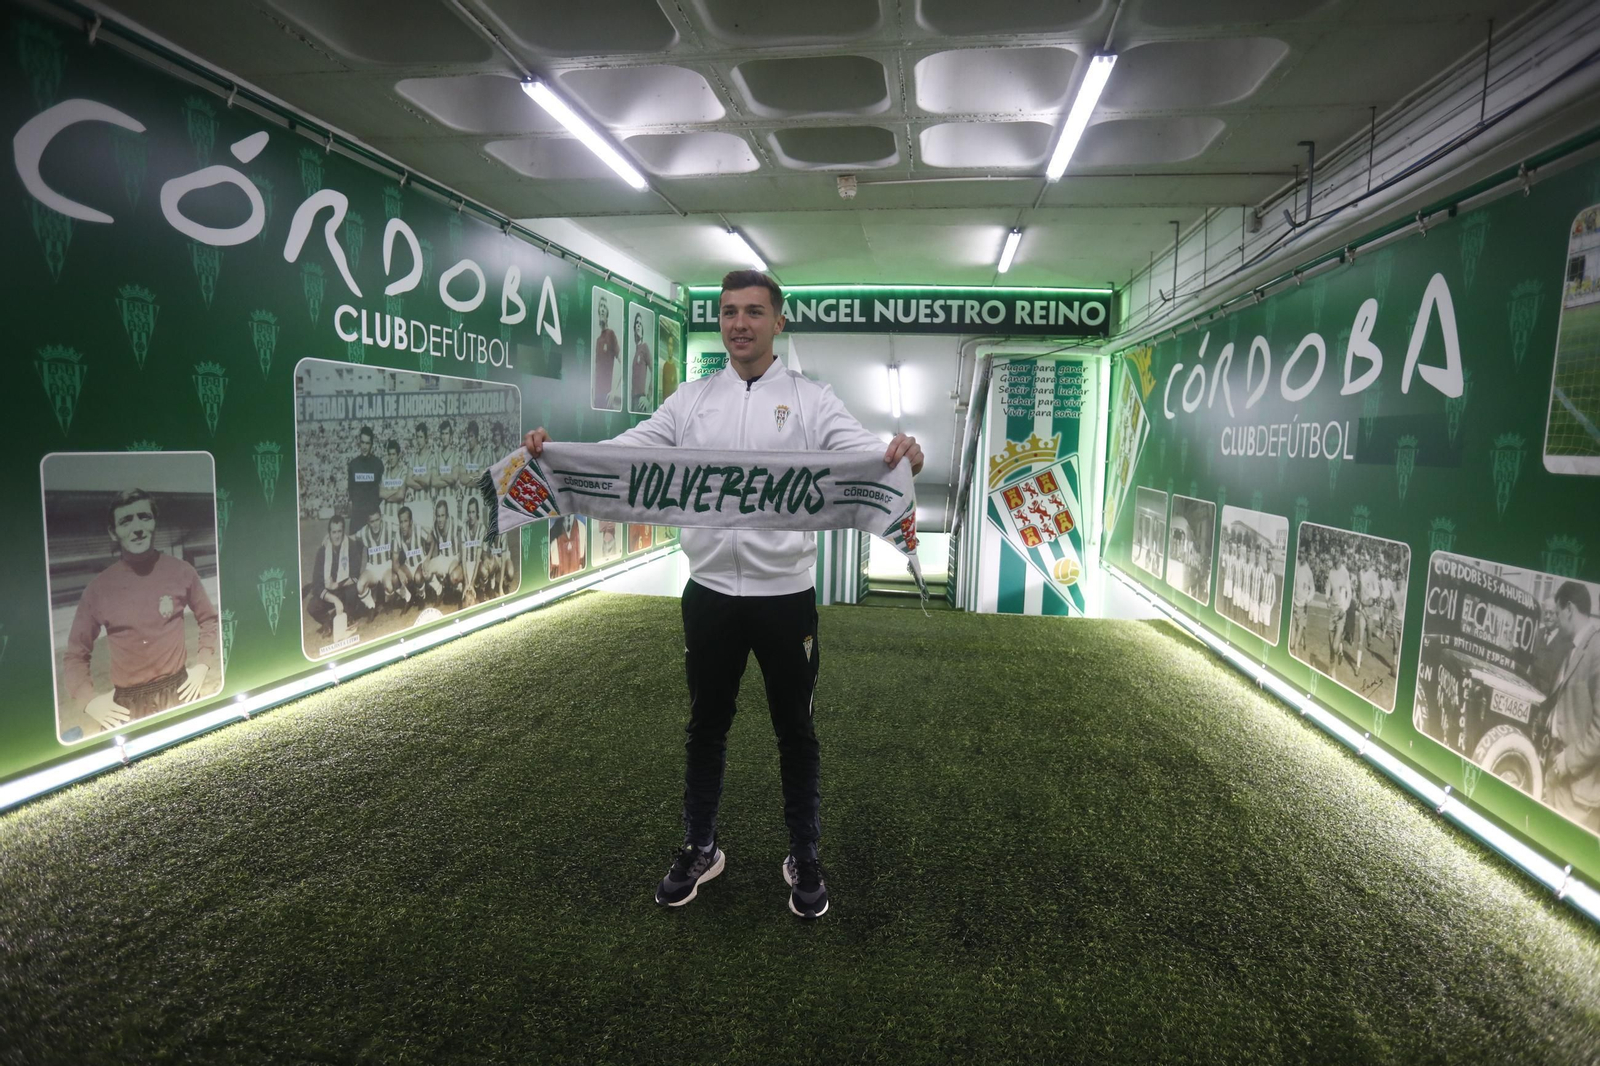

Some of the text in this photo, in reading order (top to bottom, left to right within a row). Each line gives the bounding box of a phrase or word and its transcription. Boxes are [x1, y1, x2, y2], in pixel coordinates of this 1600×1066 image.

[14, 99, 561, 345] CÓRDOBA
[692, 300, 718, 323] EL
[874, 299, 1006, 325] NUESTRO
[1015, 301, 1106, 326] REINO
[1164, 272, 1464, 419] CÓRDOBA
[1001, 363, 1089, 375] Jugar para ganar
[1000, 374, 1089, 385] Ganar para sentir
[998, 386, 1090, 397] Sentir para luchar
[305, 397, 346, 420] PIEDAD
[346, 397, 355, 419] Y
[355, 396, 383, 418] CAJA
[384, 394, 397, 417] DE
[398, 393, 446, 416] AHORROS
[447, 393, 459, 415] DE
[1001, 397, 1086, 408] Luchar para vivir
[1003, 408, 1027, 417] Vivir
[1028, 410, 1052, 419] para
[602, 482, 613, 490] CF
[627, 462, 831, 515] VOLVEREMOS
